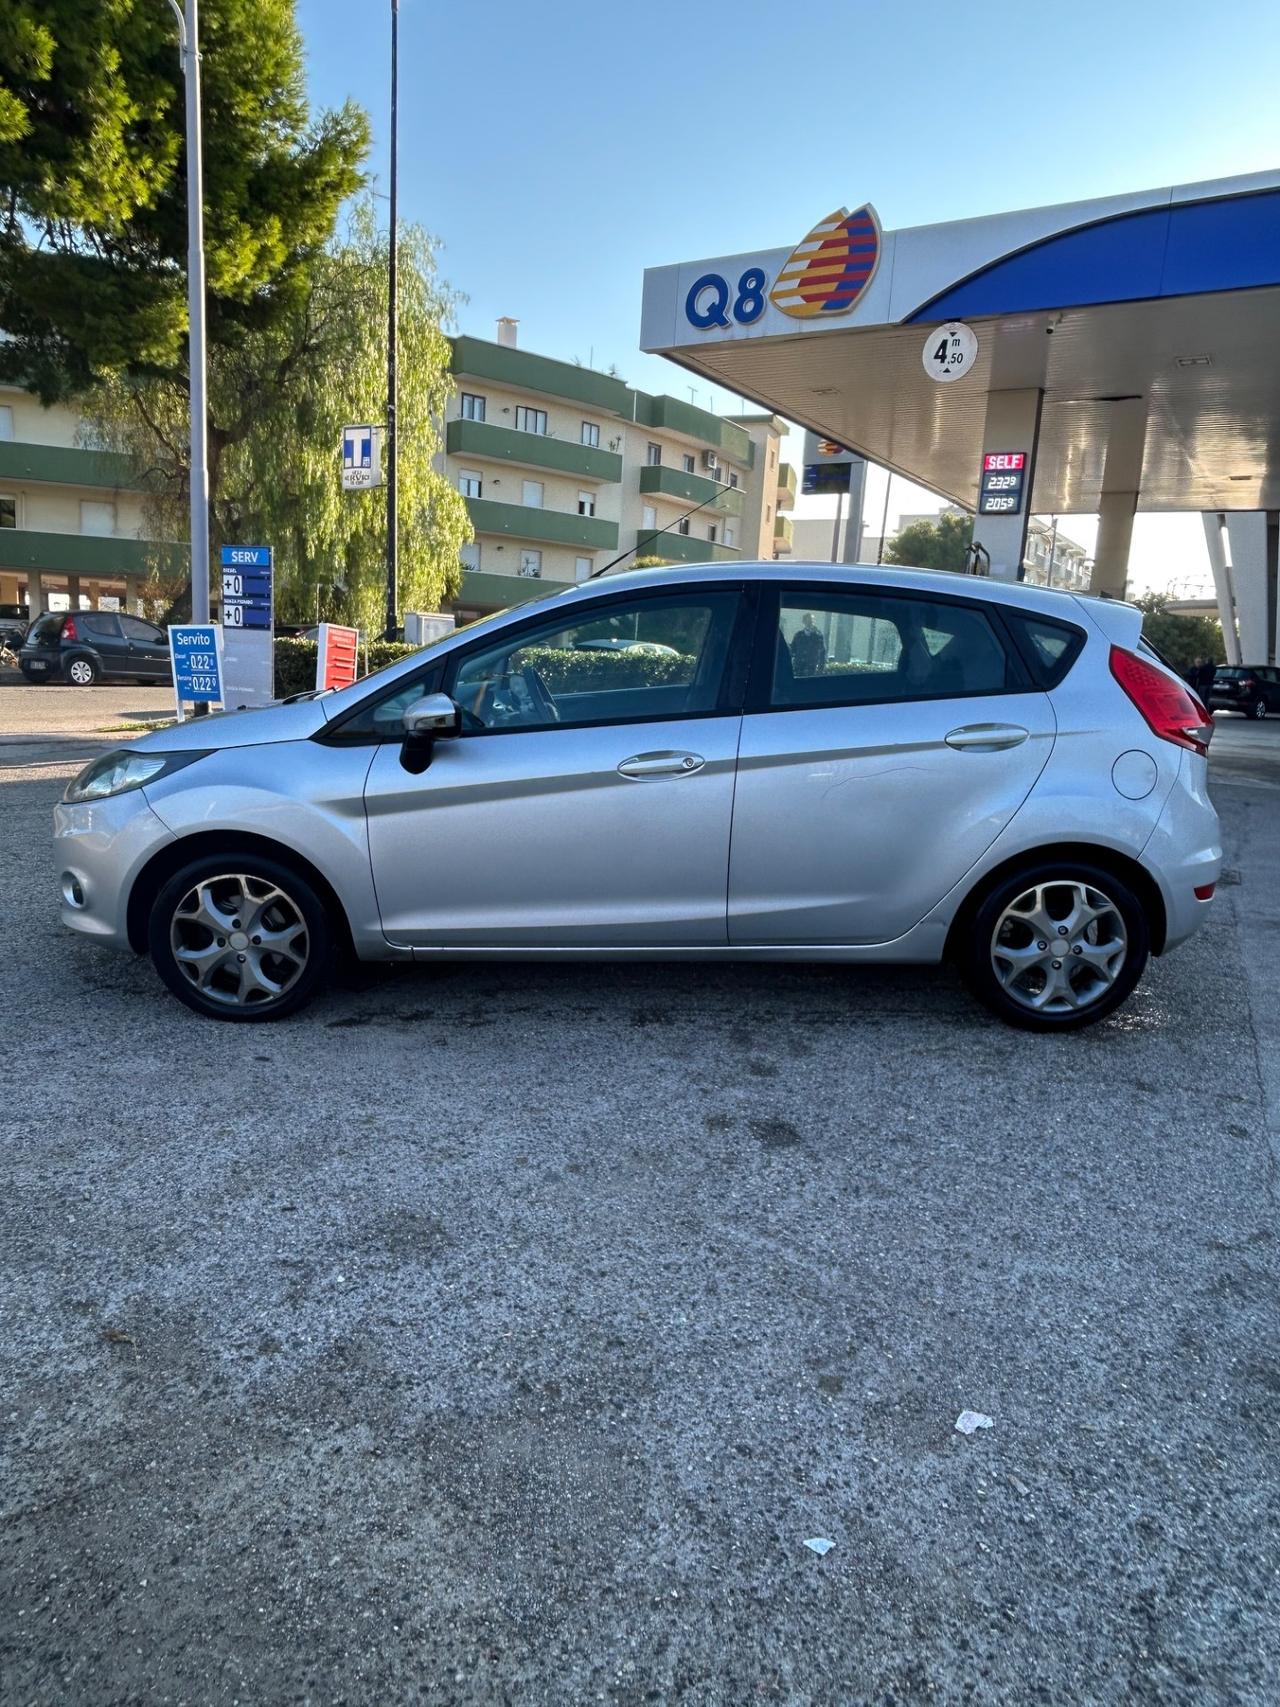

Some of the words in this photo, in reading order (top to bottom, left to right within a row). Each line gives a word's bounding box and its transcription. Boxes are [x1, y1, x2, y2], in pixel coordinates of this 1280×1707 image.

[685, 267, 766, 328] Q8
[988, 454, 1021, 470] SELF
[231, 551, 259, 563] SERV
[177, 632, 211, 646] Servito
